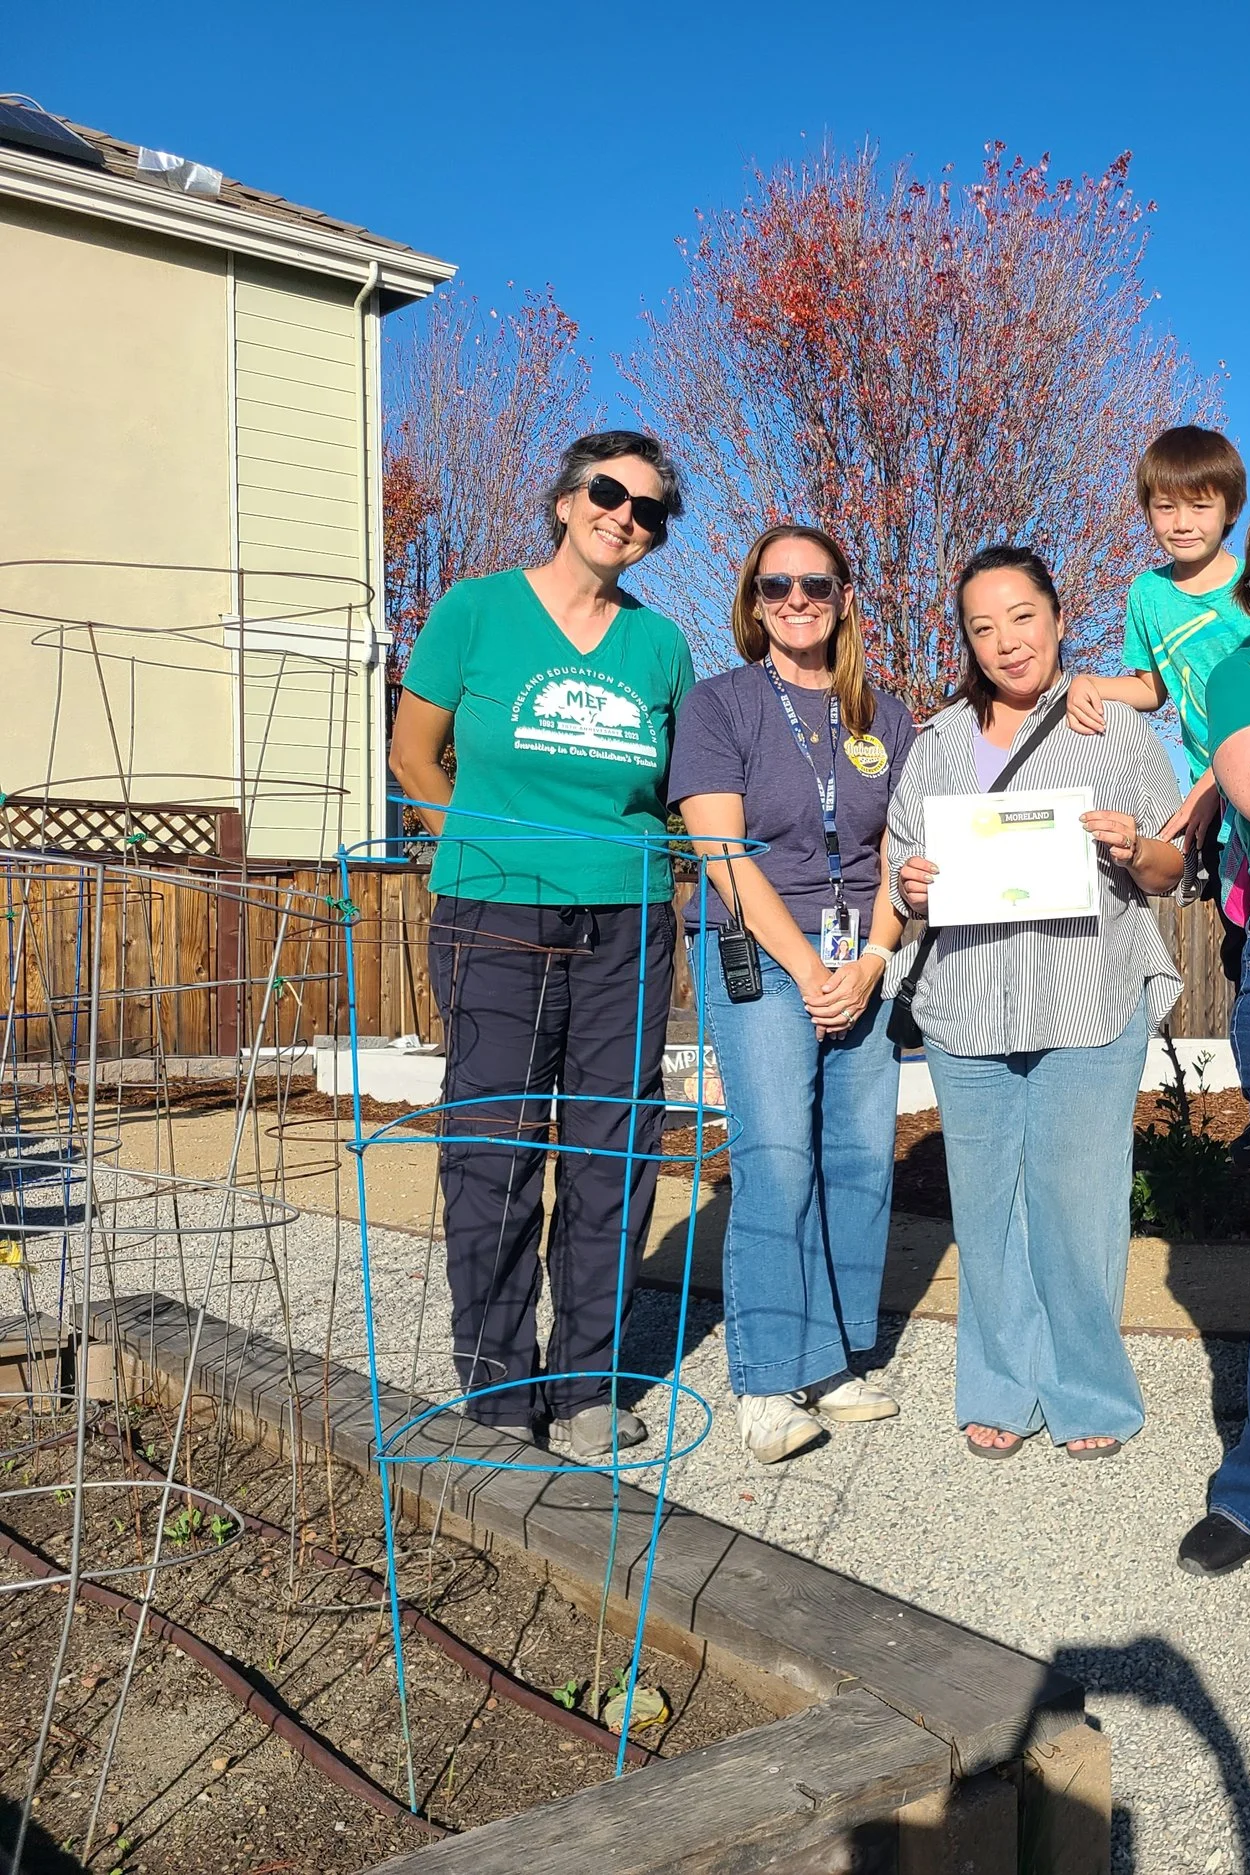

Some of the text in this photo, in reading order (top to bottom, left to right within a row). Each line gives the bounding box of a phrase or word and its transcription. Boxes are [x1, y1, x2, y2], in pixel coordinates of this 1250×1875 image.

[511, 666, 657, 744] MORELAND EDUCATION FOUNDATION
[567, 690, 607, 711] MEF
[780, 695, 798, 725] BAKER
[557, 745, 568, 754] in
[569, 746, 588, 756] Our
[589, 748, 632, 763] Children's
[1005, 811, 1050, 822] MORELAND
